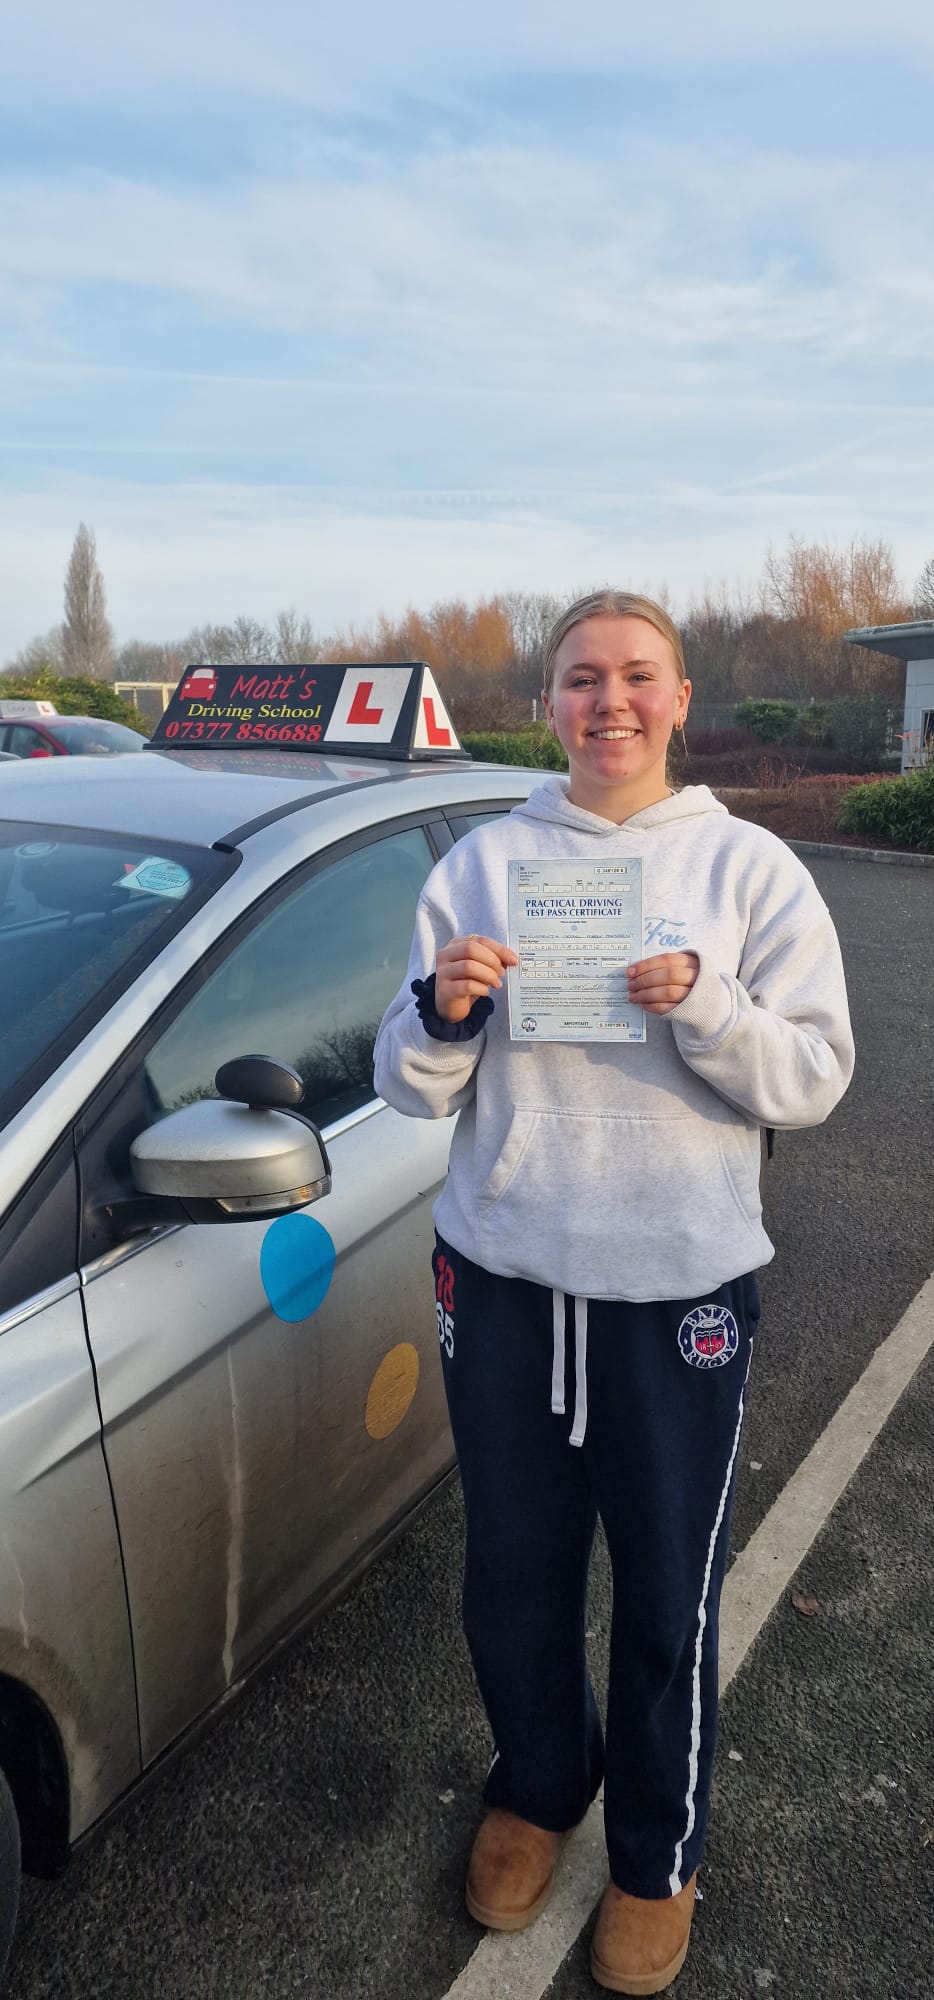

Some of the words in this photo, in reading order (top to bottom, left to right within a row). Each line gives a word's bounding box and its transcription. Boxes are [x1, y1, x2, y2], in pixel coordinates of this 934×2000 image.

[230, 667, 317, 700] Matt's
[188, 703, 252, 719] Driving
[258, 704, 321, 719] School
[346, 682, 384, 724] L
[165, 721, 231, 740] 07377
[236, 723, 322, 742] 856688
[422, 697, 451, 746] L
[525, 898, 576, 908] PRACTICAL
[580, 898, 623, 907] DRIVING
[526, 908, 544, 917] TEST
[547, 908, 567, 917] PASS
[569, 908, 623, 916] CERTIFICATE
[437, 1255, 455, 1313] 18
[685, 1307, 729, 1328] BATH
[686, 1342, 735, 1367] RUGBY
